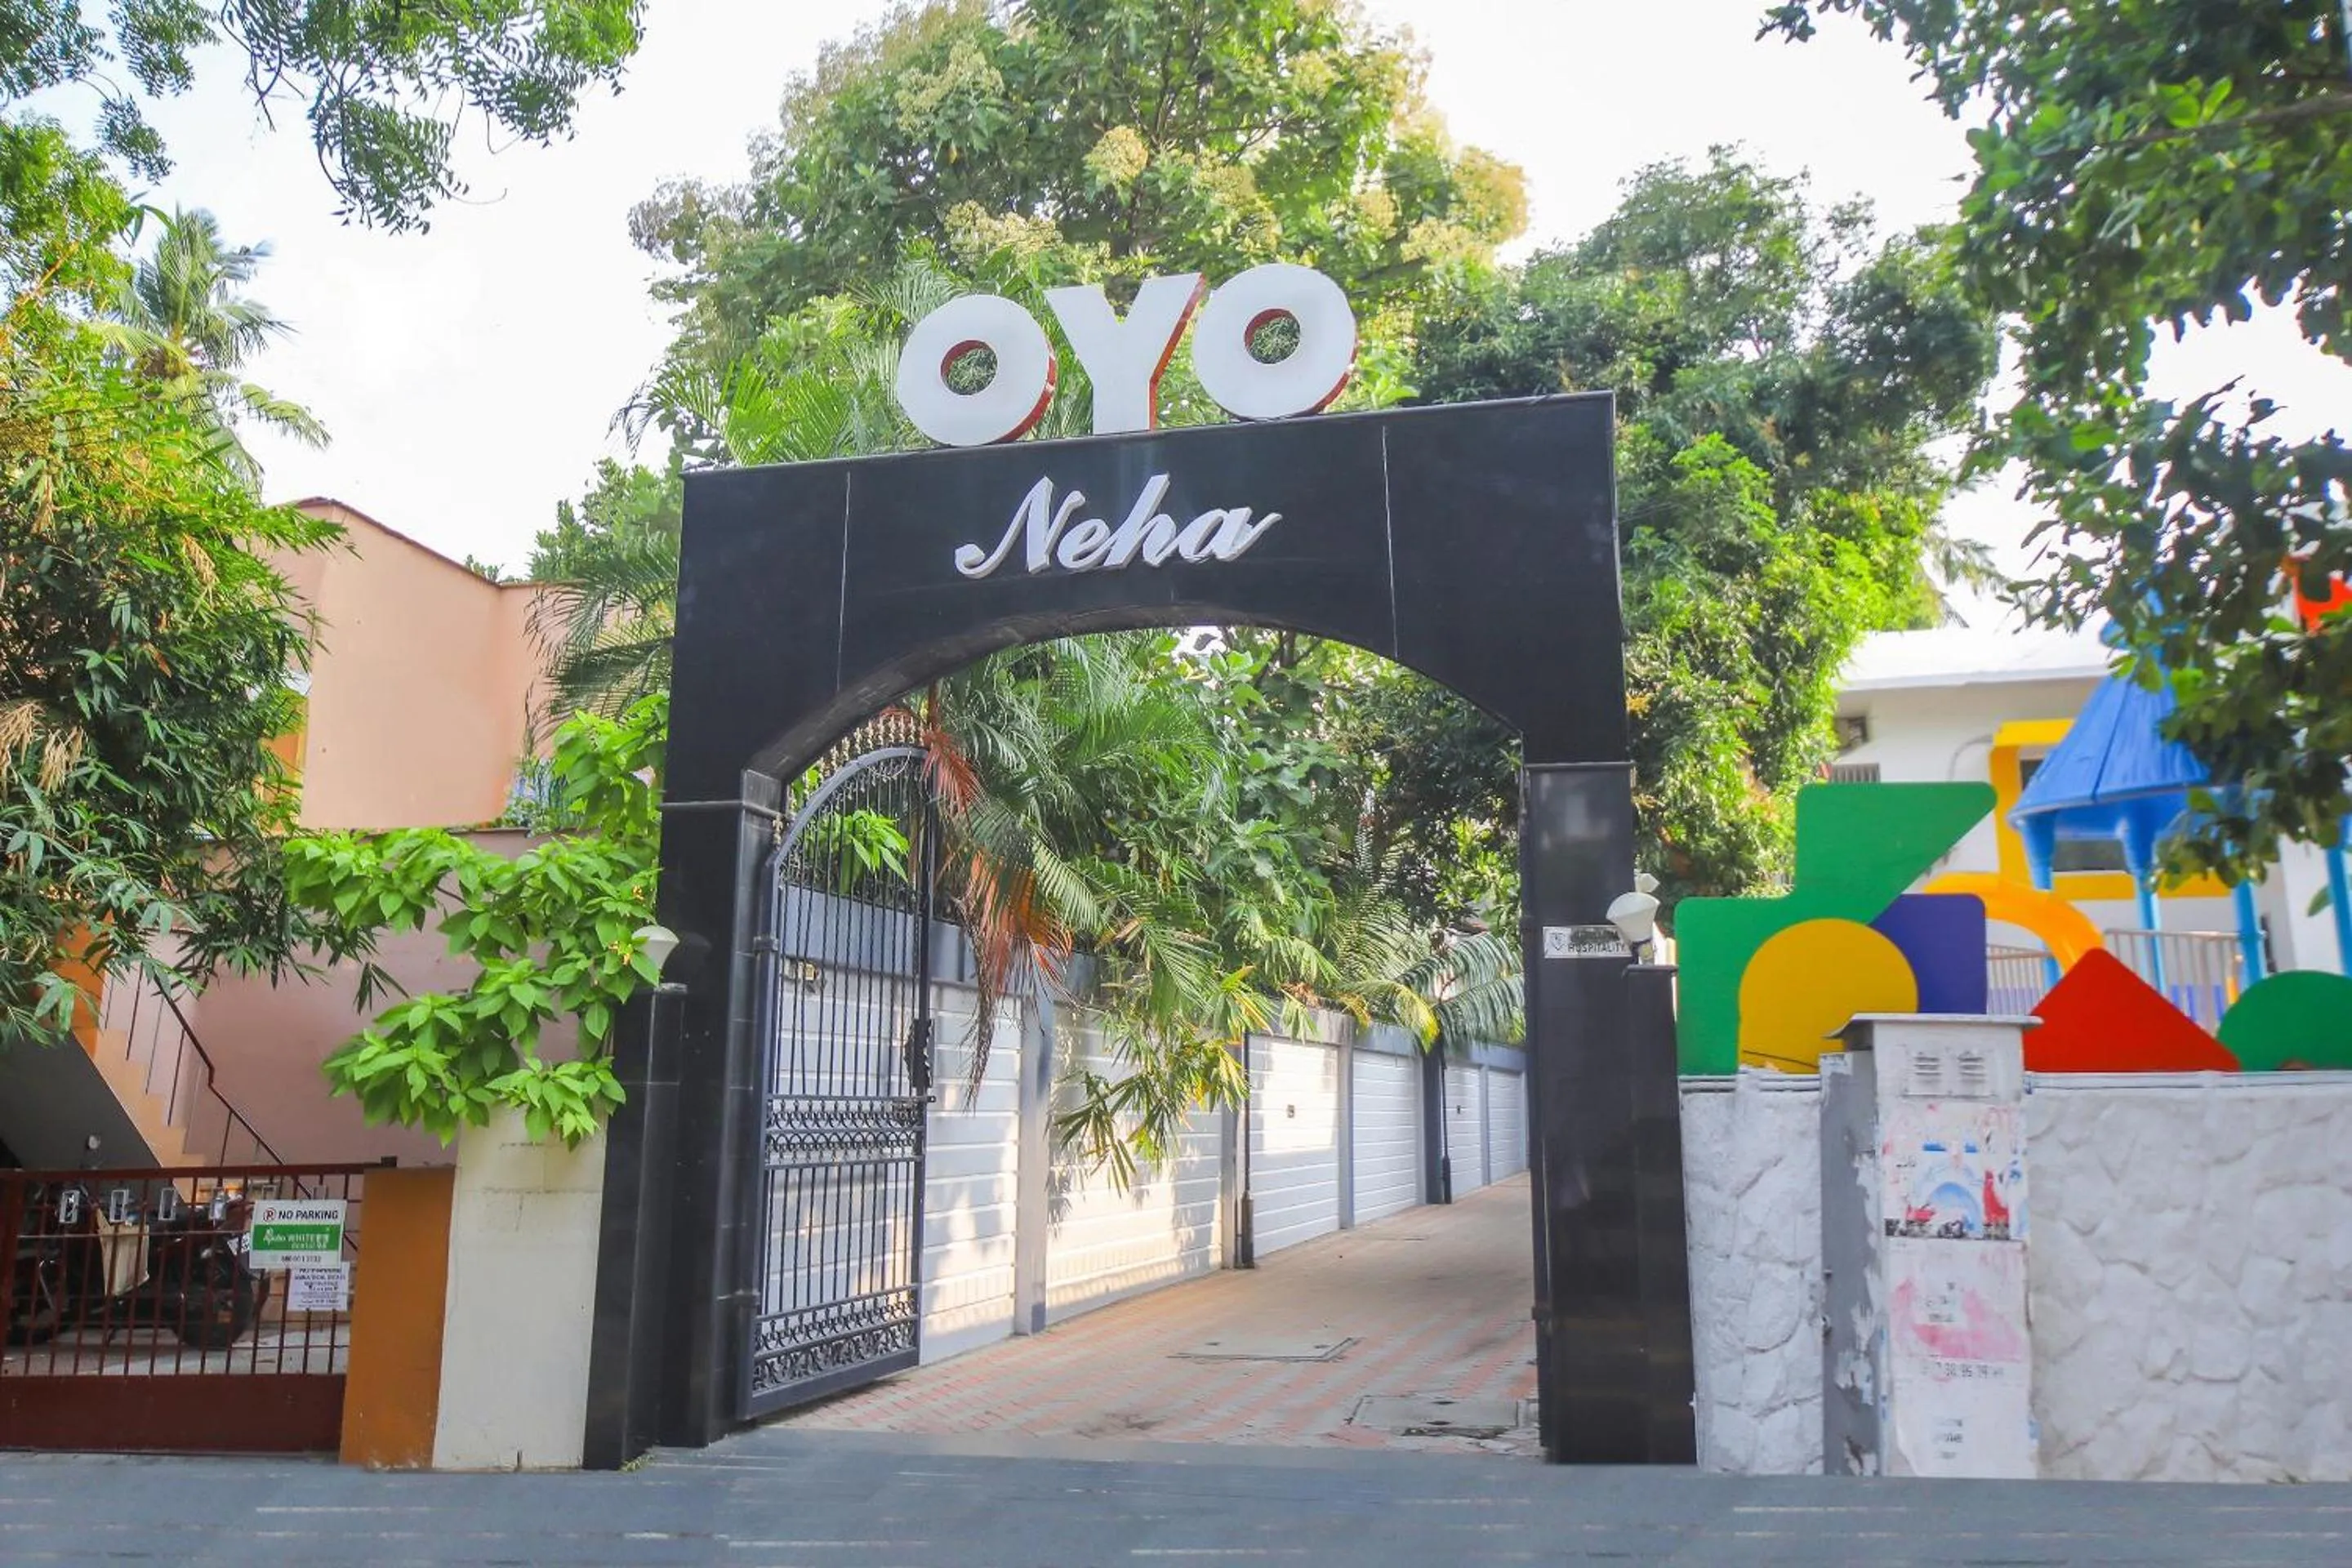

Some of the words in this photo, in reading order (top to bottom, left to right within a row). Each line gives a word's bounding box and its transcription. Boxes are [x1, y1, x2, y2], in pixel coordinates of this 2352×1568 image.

[897, 262, 1359, 448] OYO
[954, 471, 1282, 579] Neha
[278, 1209, 294, 1219] NO
[296, 1209, 338, 1219] PARKING
